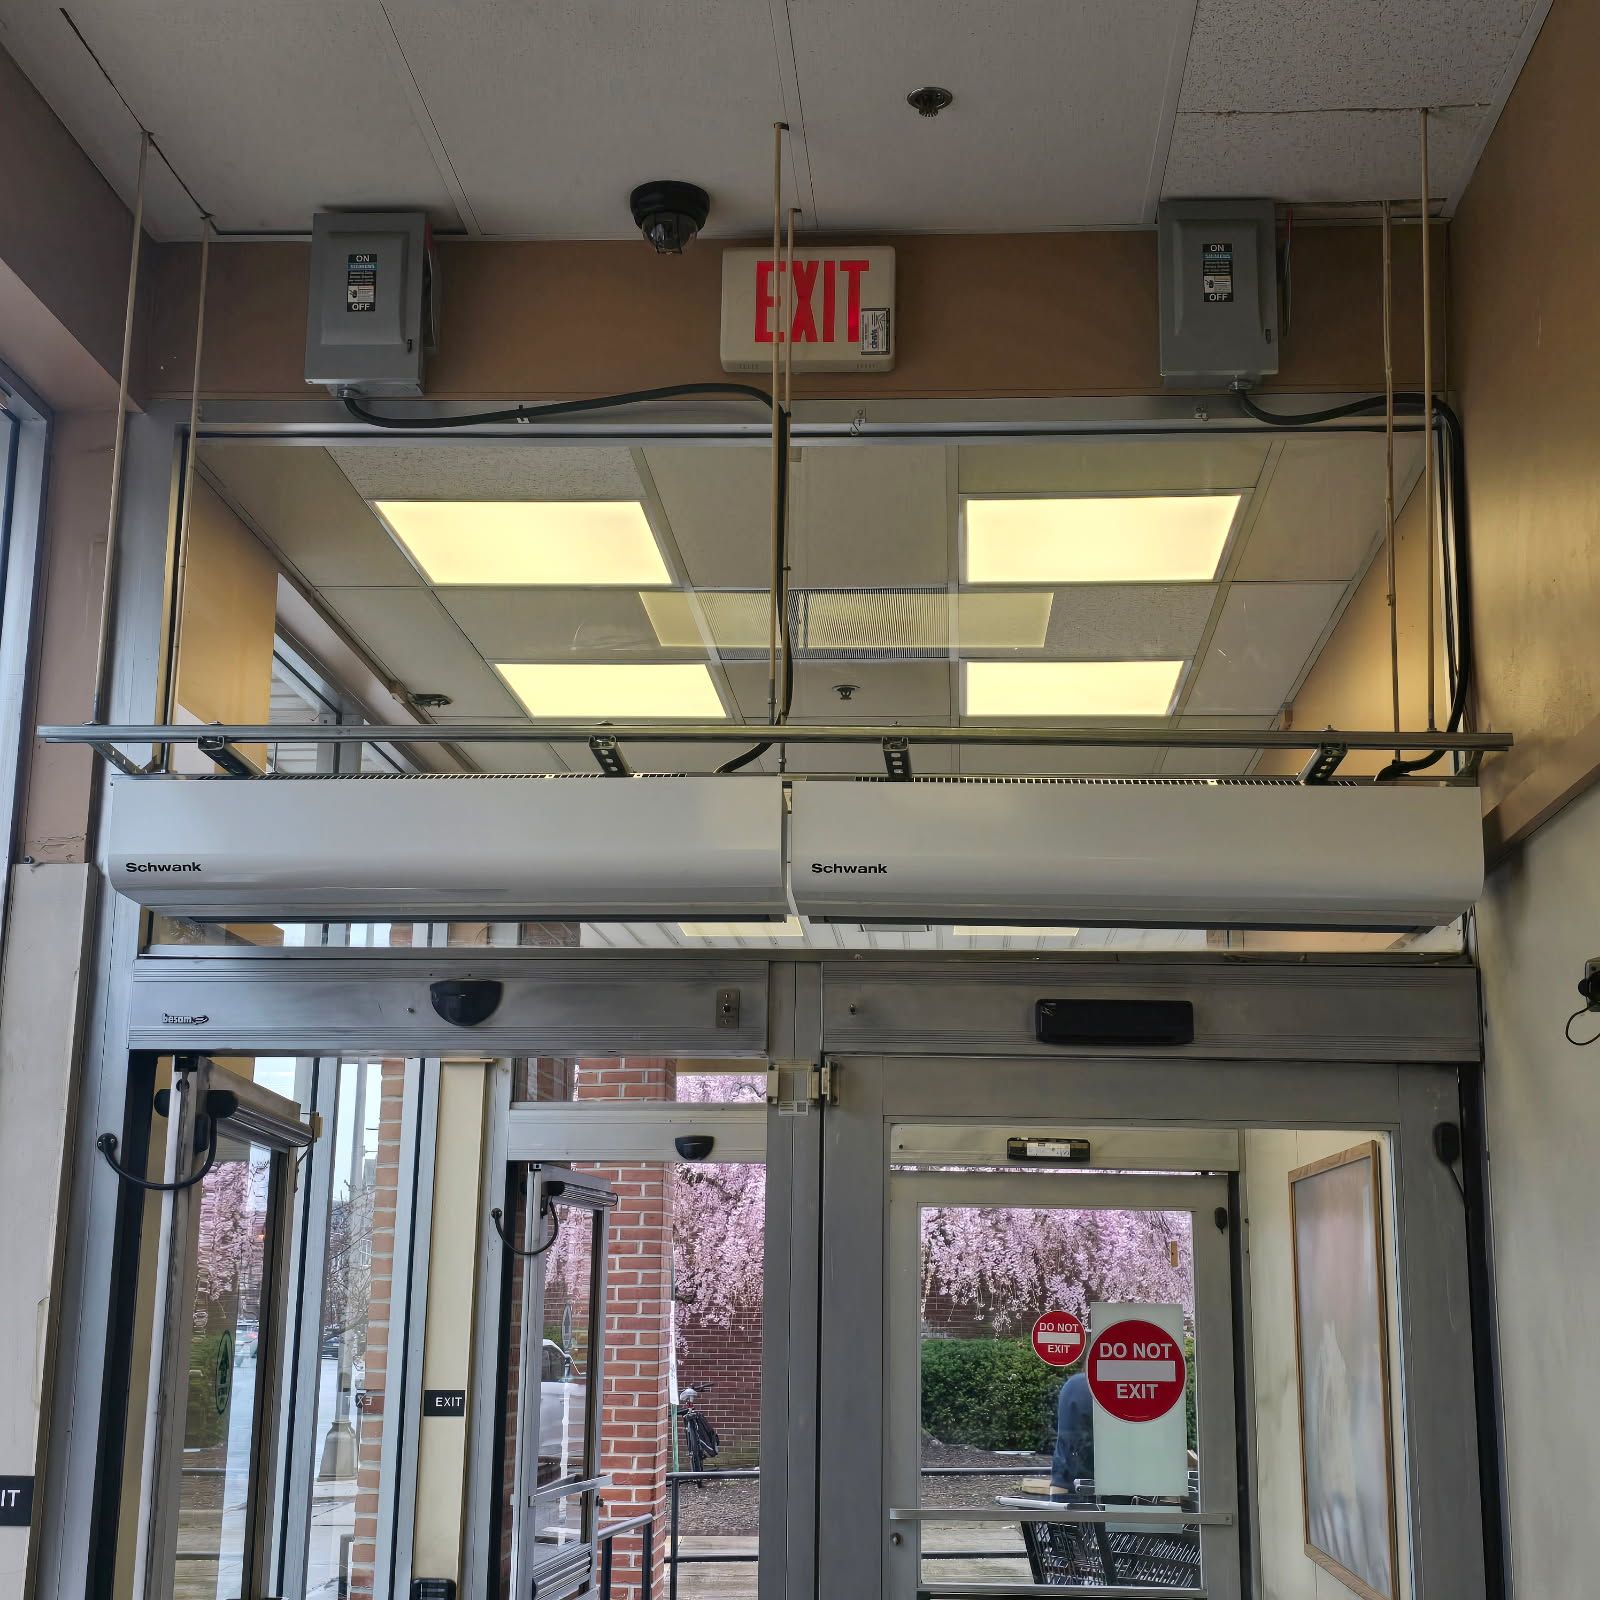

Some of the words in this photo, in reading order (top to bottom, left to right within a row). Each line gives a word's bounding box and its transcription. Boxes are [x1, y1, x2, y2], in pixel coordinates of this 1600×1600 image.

[1210, 244, 1225, 252] ON
[754, 260, 870, 343] EXIT
[1209, 293, 1228, 301] OFF
[351, 303, 371, 311] OFF
[125, 862, 202, 873] Schwank
[811, 863, 888, 874] Schwank
[162, 1013, 193, 1025] besam
[1039, 1322, 1054, 1332] DO
[1057, 1323, 1079, 1333] NOT
[1047, 1344, 1071, 1354] EXIT
[1099, 1342, 1127, 1359] DO
[1133, 1342, 1172, 1359] NOT
[1116, 1383, 1159, 1399] EXIT
[435, 1396, 463, 1407] EXIT
